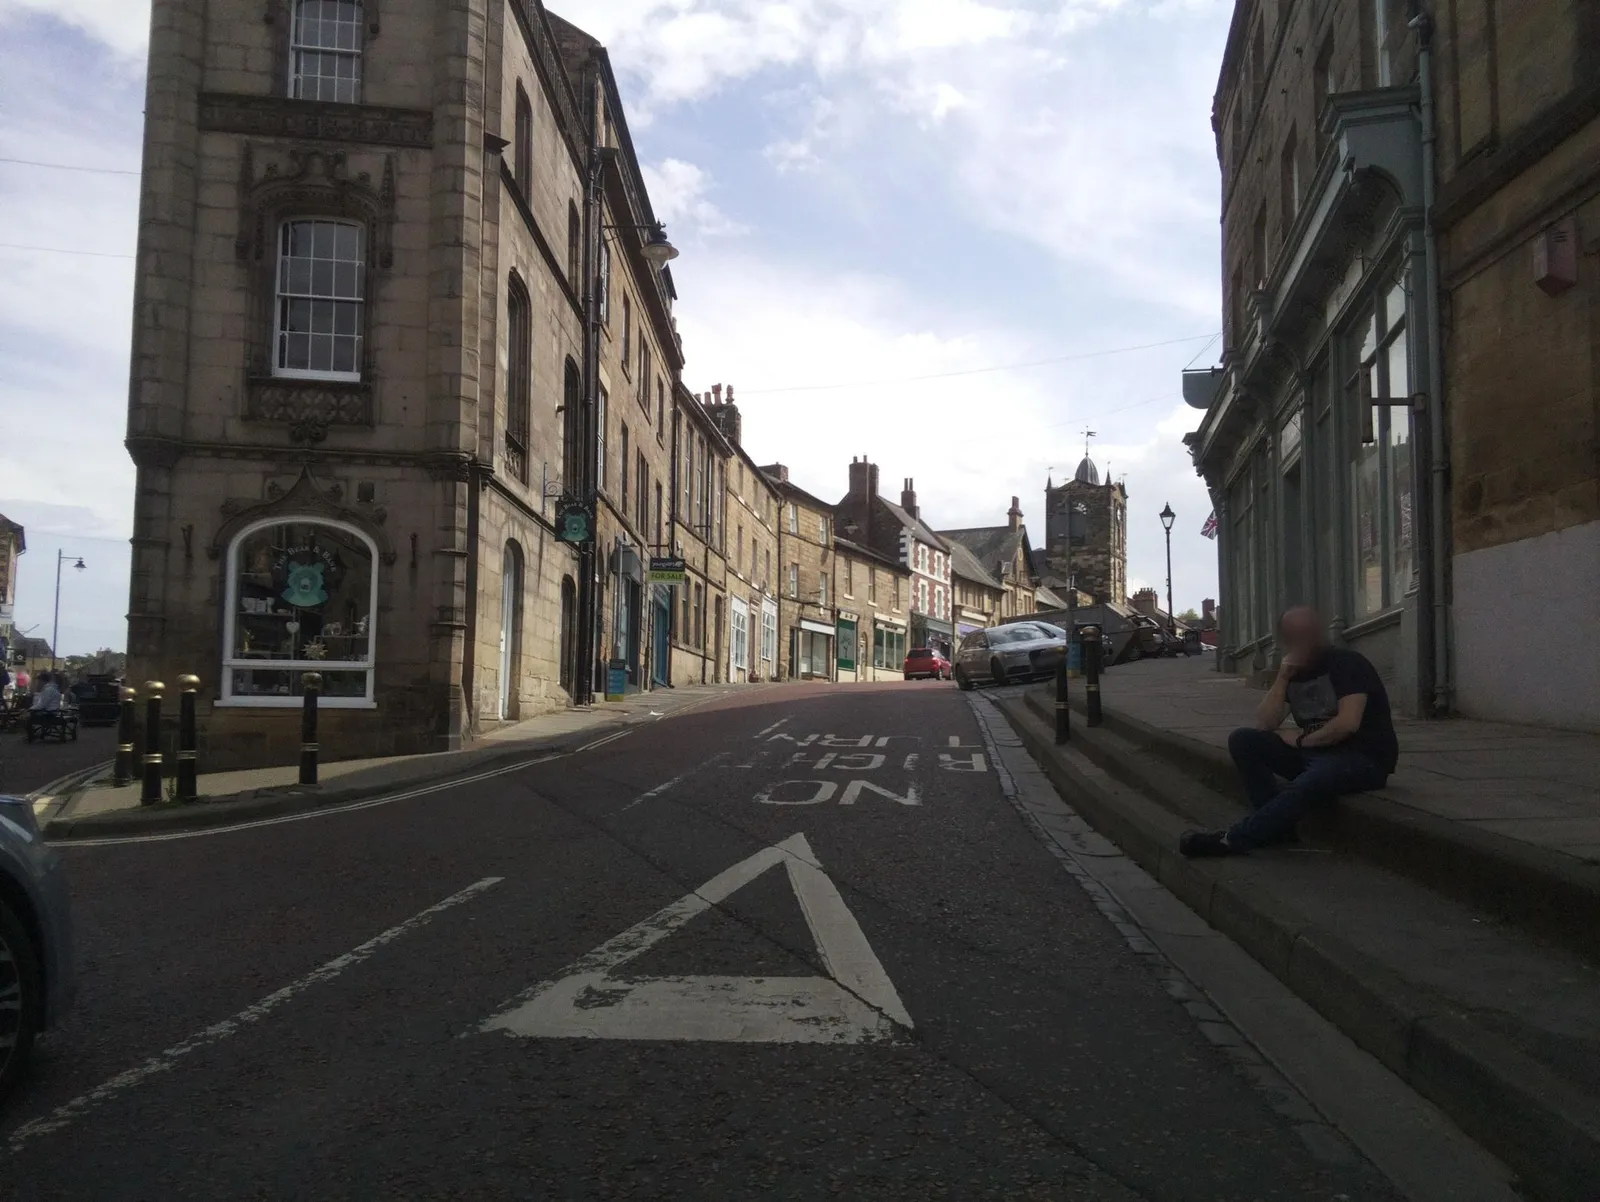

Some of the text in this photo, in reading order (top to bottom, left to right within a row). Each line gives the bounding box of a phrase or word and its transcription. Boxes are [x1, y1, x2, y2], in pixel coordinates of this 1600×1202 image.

[651, 572, 683, 580] FOR SALE
[753, 780, 922, 805] NO
